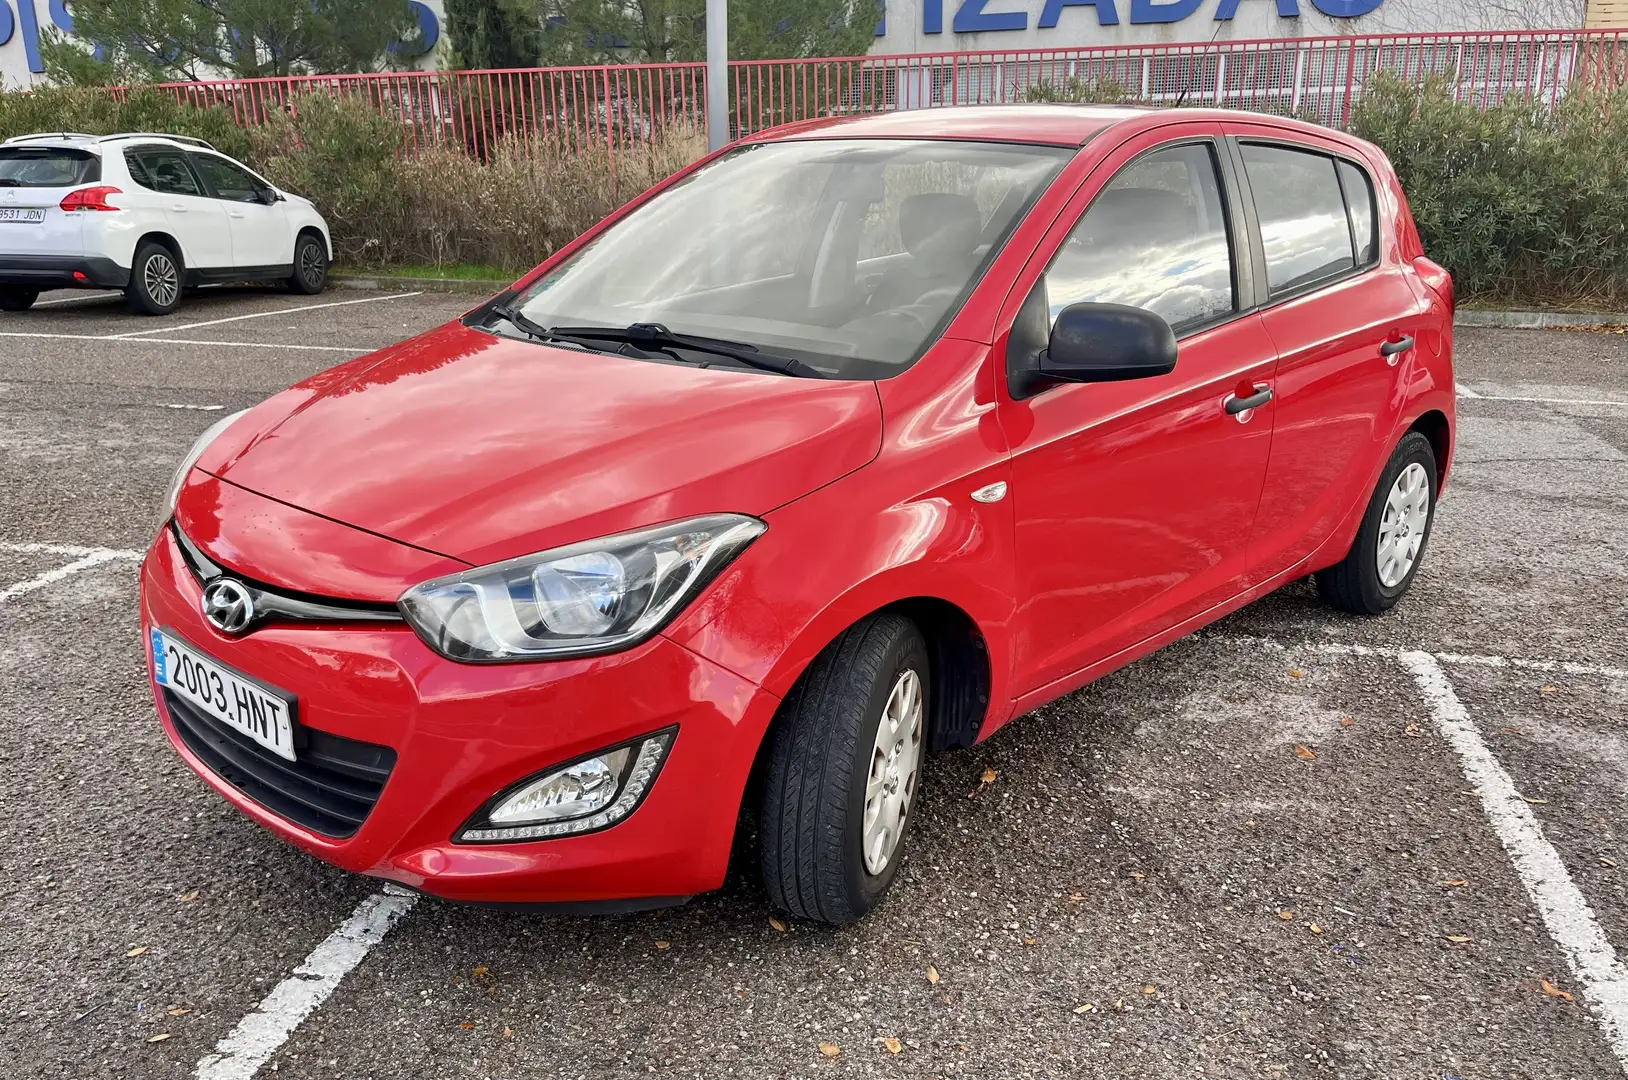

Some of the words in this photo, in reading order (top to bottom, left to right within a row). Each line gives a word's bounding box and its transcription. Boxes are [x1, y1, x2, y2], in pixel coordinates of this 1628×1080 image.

[24, 210, 42, 220] JDN
[169, 646, 228, 713] 2003
[232, 681, 280, 746] HNT
